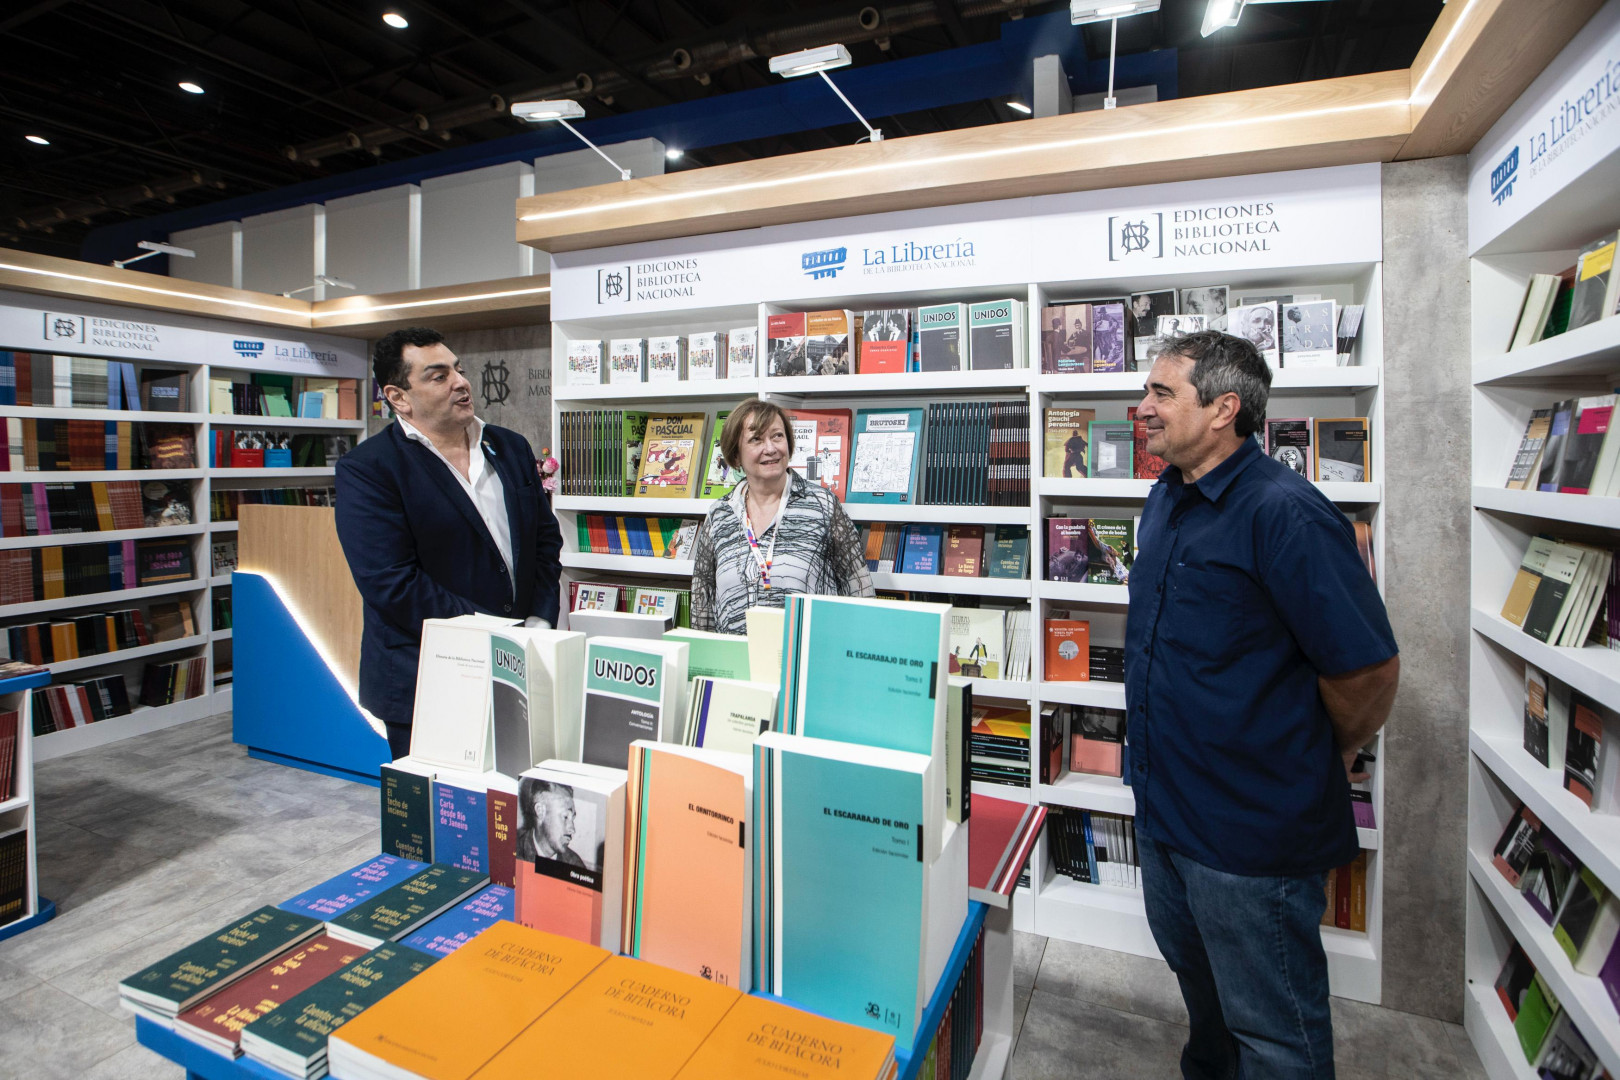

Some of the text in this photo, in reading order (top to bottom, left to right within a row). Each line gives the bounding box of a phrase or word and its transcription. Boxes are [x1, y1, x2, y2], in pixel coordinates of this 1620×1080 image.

[1530, 133, 1547, 165] La
[1174, 202, 1274, 224] EDICIONES
[1174, 220, 1280, 241] BIBLIOTECA
[863, 238, 975, 266] La Librería
[1174, 238, 1272, 258] NACIONAL
[636, 258, 698, 275] EDICIONES
[886, 262, 932, 273] BIBLIOTECA
[934, 259, 976, 269] NACIONAL
[636, 272, 702, 288] BIBLIOTECA
[636, 286, 696, 302] NACIONAL
[922, 311, 956, 324] UNIDOS
[974, 308, 1008, 320] UNIDOS
[92, 318, 156, 333] EDICIONES
[92, 328, 160, 343] BIBLIOTECA
[92, 338, 154, 352] NACIONAL
[274, 344, 290, 358] La
[290, 347, 338, 363] Librería
[666, 416, 684, 424] DON
[656, 424, 693, 436] PASCUAL
[581, 590, 605, 602] QUE
[639, 594, 665, 608] QUE
[846, 650, 924, 668] EL ESCARABAJO DE ORO
[594, 658, 656, 687] UNIDOS
[730, 712, 756, 722] TRAPALANDA
[387, 788, 392, 797] El
[387, 798, 408, 810] techo de
[439, 798, 455, 810] Carta
[387, 806, 408, 819] incienso
[440, 808, 466, 822] desde Río
[494, 812, 502, 822] La
[688, 803, 734, 825] EL ORNITORRINCO
[824, 807, 909, 830] EL ESCARABAJO DE ORO
[440, 817, 468, 831] de Janeiro
[495, 822, 508, 832] luna
[495, 831, 508, 842] roja
[891, 836, 906, 845] Tomo
[395, 840, 423, 856] Cuentos de
[399, 850, 406, 858] la
[462, 855, 480, 868] Río es
[570, 870, 580, 879] Obra
[500, 942, 562, 966] CUADERNO
[484, 948, 556, 978] DE BITÁCORA
[620, 978, 692, 1007] CUADERNO
[604, 986, 686, 1020] DE BITÁCORA
[760, 1022, 843, 1055] CUADERNO
[746, 1032, 841, 1070] DE BITÁCORA
